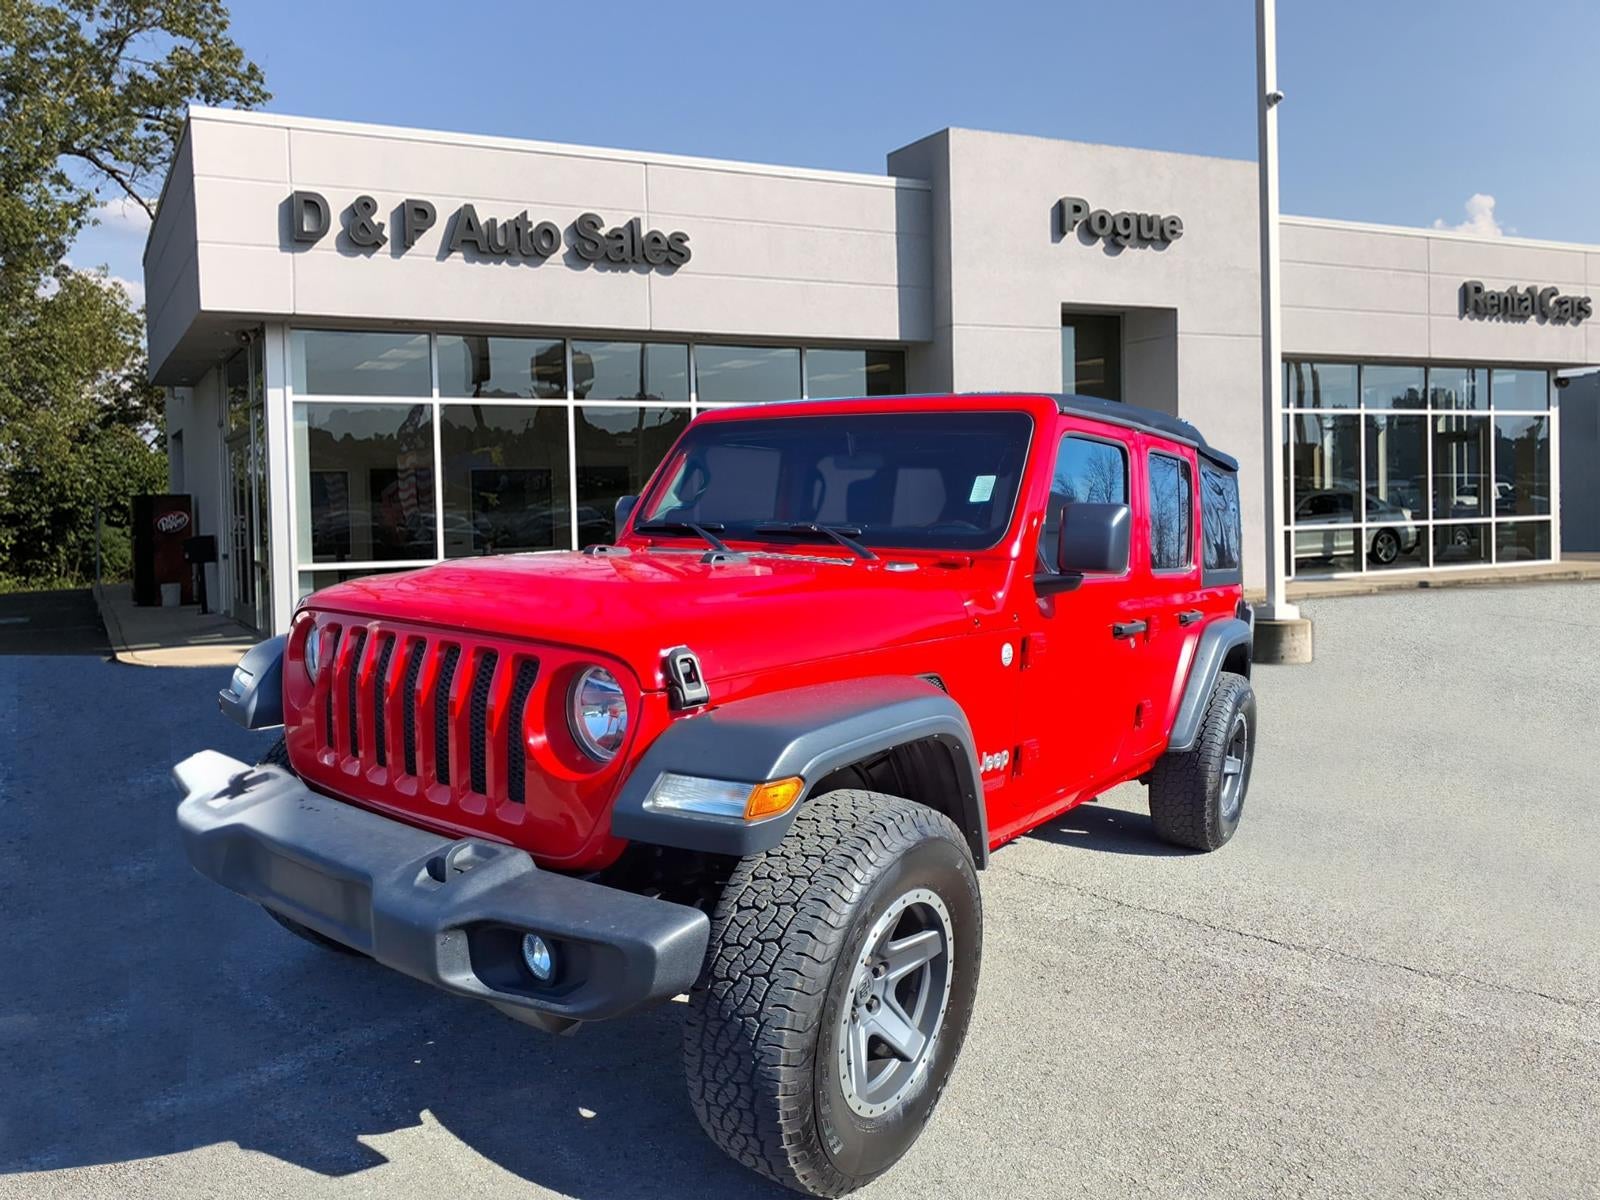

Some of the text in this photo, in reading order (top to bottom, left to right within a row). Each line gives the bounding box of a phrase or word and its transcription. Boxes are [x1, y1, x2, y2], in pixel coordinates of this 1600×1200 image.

[292, 190, 692, 267] D & P Auto Sales
[1060, 197, 1184, 247] Pogue
[1463, 280, 1593, 321] Rental Cars
[980, 750, 1010, 774] Jeep
